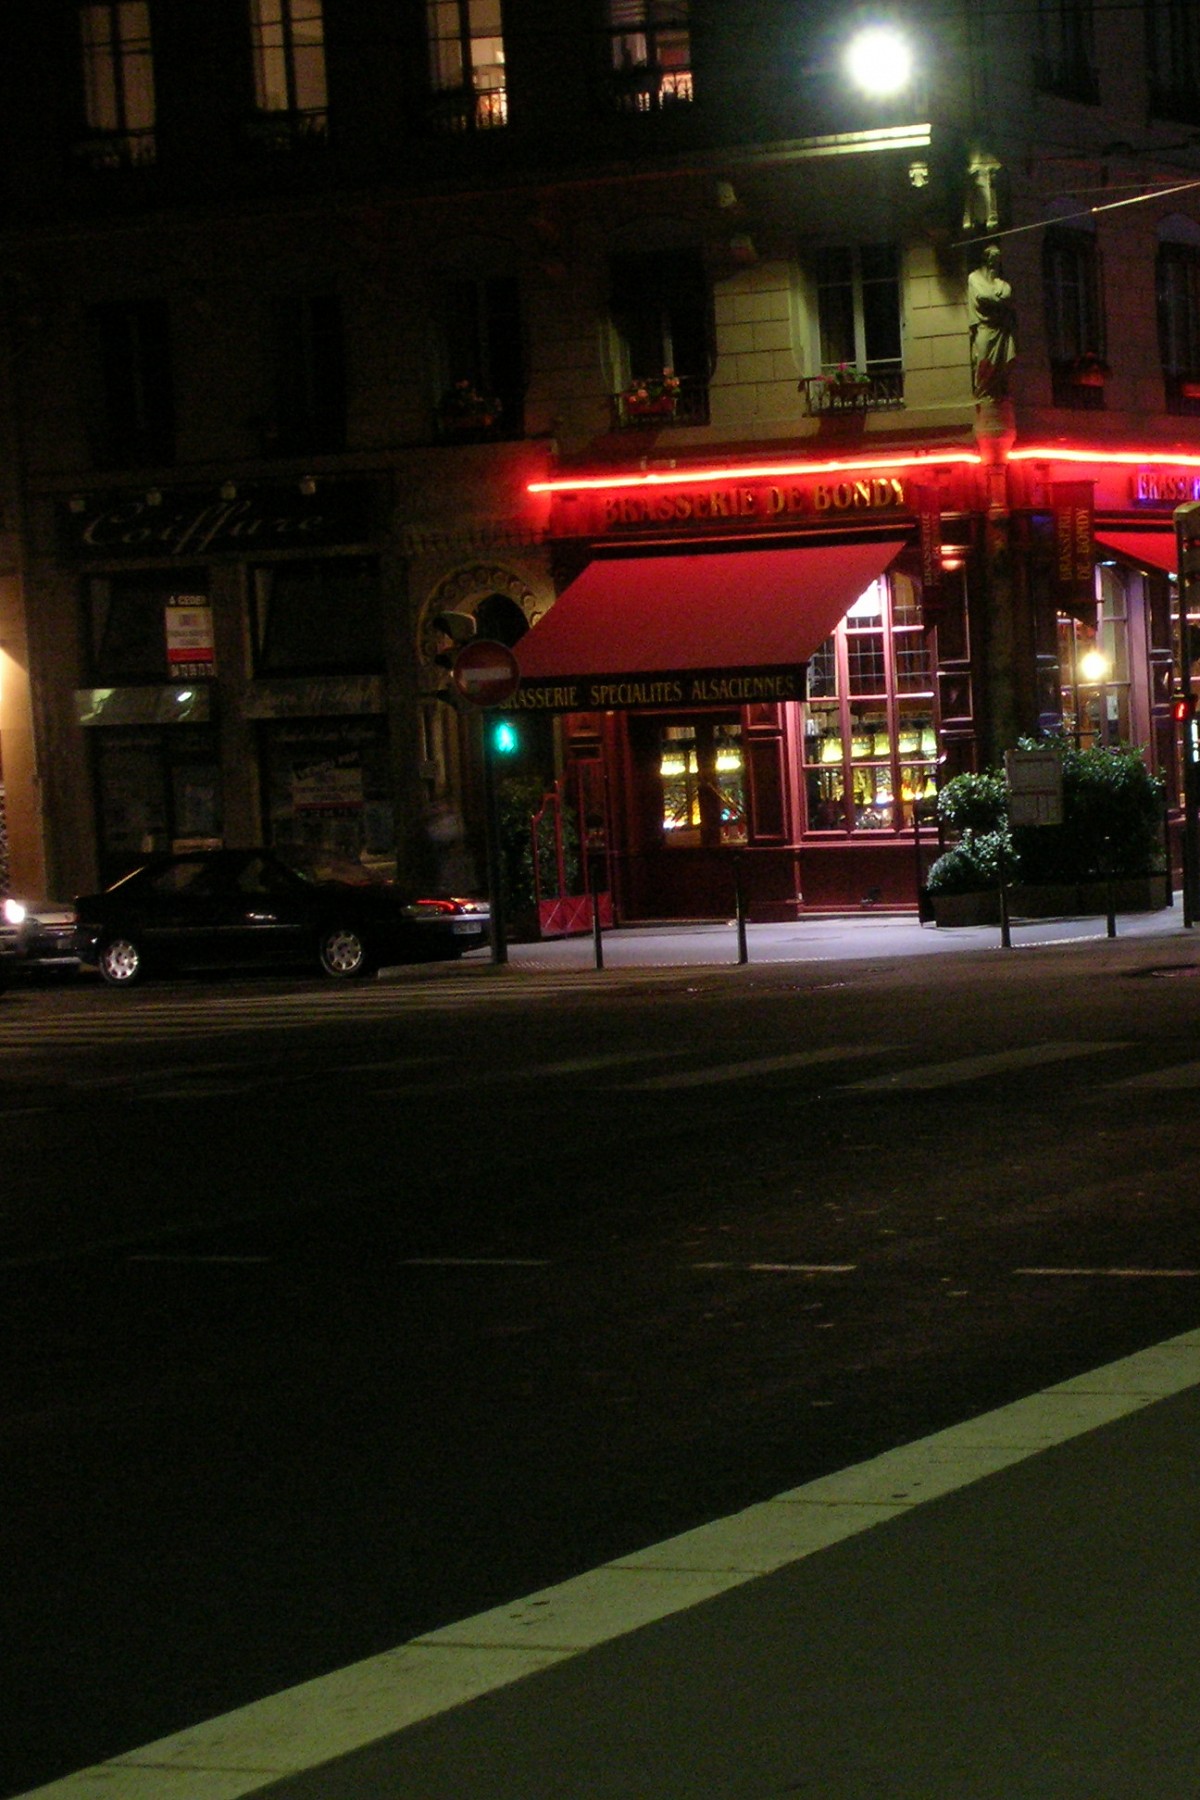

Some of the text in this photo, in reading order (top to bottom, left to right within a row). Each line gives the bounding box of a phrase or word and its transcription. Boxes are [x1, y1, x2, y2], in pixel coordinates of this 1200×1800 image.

[605, 477, 906, 523] BRASSERIE DE BONDY
[589, 680, 683, 706] SPECIALITES
[691, 674, 795, 701] ALSACIENNES
